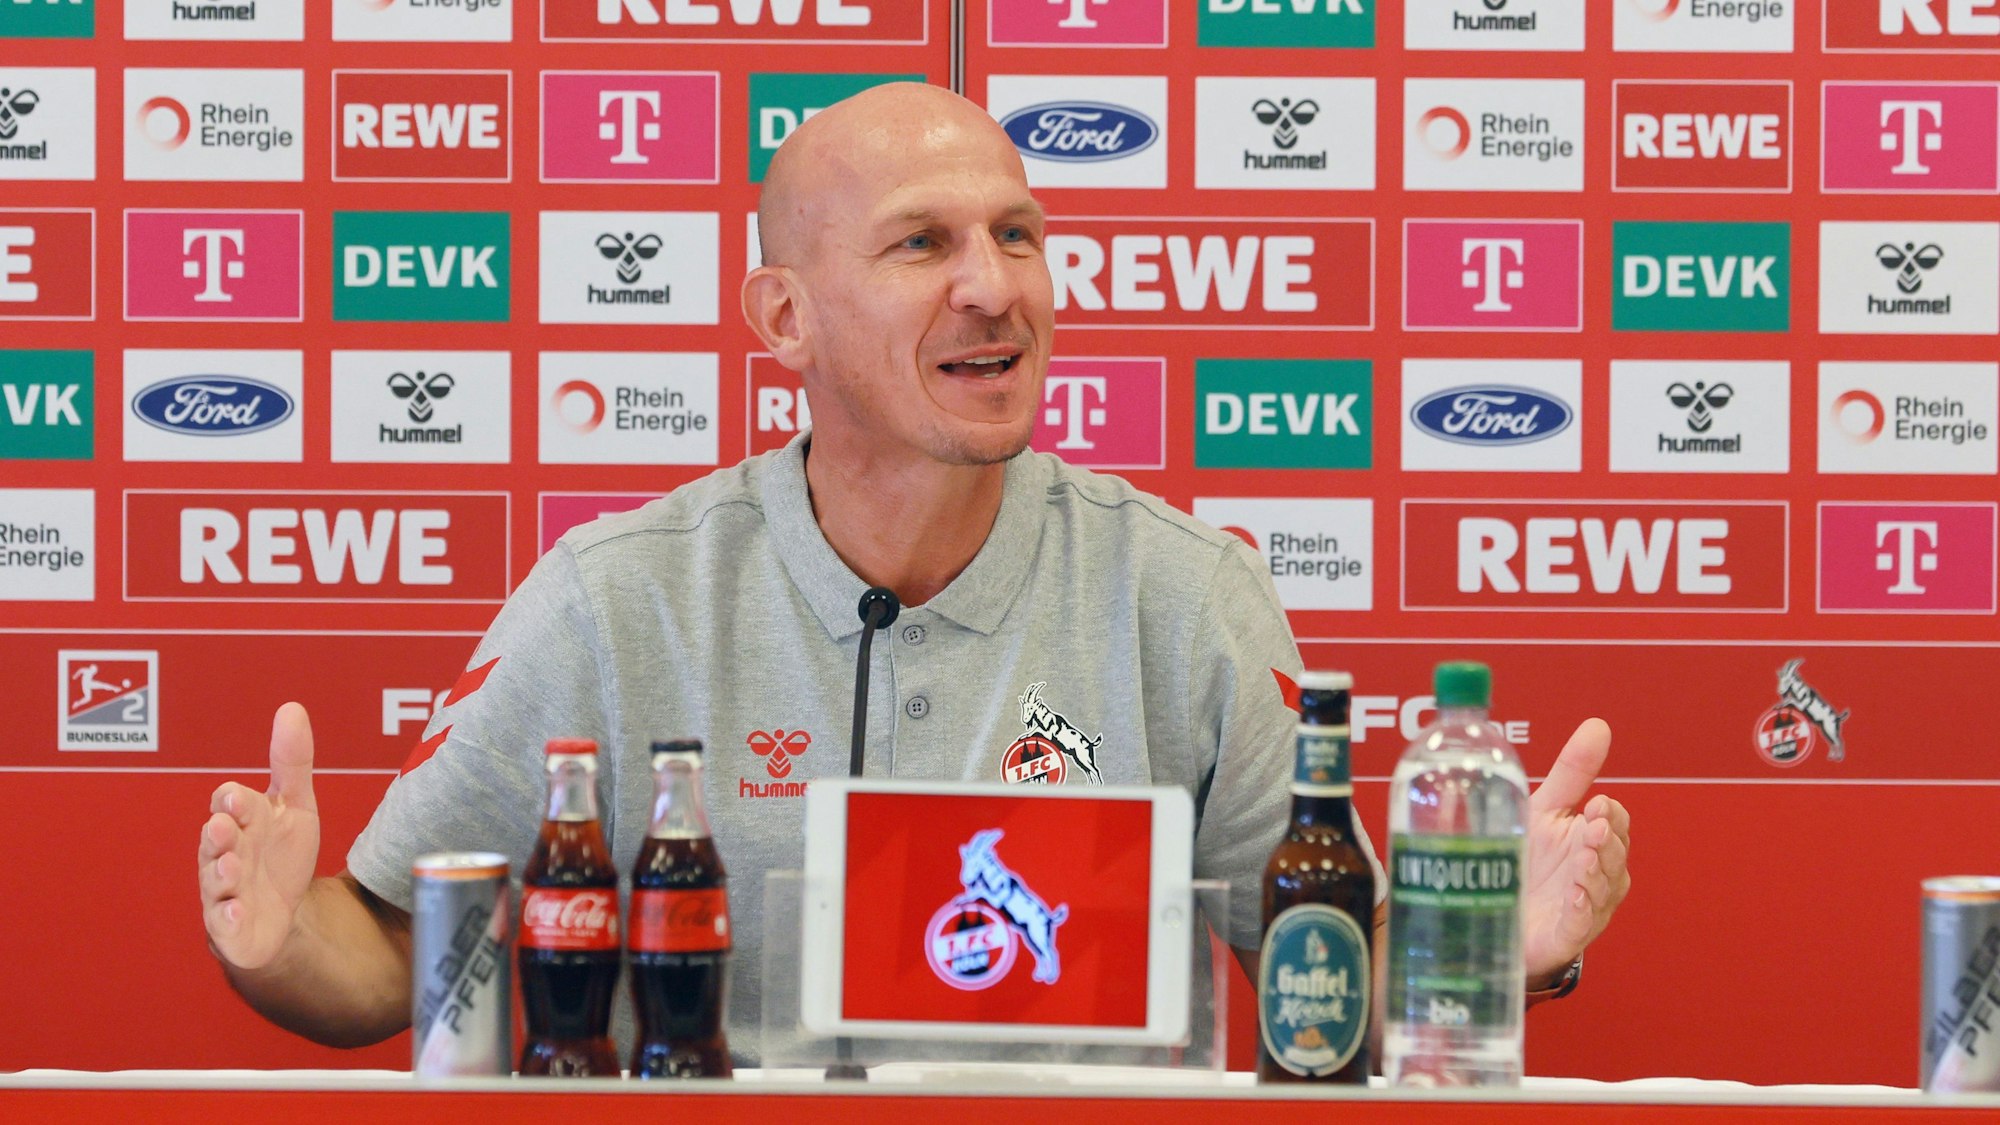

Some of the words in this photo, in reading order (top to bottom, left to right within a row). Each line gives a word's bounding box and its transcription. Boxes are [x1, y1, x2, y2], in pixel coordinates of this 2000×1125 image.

[174, 3, 254, 20] hummel
[1454, 12, 1535, 30] hummel
[202, 104, 268, 123] Rhein
[344, 104, 499, 148] REWE
[600, 91, 659, 163] T
[1483, 114, 1548, 133] Rhein
[202, 127, 292, 150] Energie
[1028, 109, 1126, 151] Ford
[1625, 114, 1780, 158] REWE
[1881, 101, 1941, 173] T
[1245, 150, 1326, 169] hummel
[1482, 137, 1572, 159] Energie
[184, 229, 243, 301] T
[345, 247, 496, 286] DEVK
[1045, 236, 1316, 311] REWE
[1463, 239, 1523, 311] T
[1625, 257, 1776, 296] DEVK
[589, 284, 669, 303] hummel
[1868, 294, 1950, 313] hummel
[163, 384, 260, 427] Ford
[617, 388, 682, 407] Rhein
[1897, 398, 1962, 416] Rhein
[617, 410, 706, 434] Energie
[1046, 377, 1105, 448] T
[1207, 394, 1358, 434] DEVK
[1441, 394, 1538, 437] Ford
[380, 424, 461, 443] hummel
[1659, 433, 1740, 452] hummel
[1896, 420, 1986, 443] Energie
[181, 509, 452, 584] REWE
[1271, 534, 1336, 552] Rhein
[1459, 519, 1730, 593] REWE
[1271, 556, 1361, 580] Energie
[1877, 522, 1937, 593] T
[122, 692, 144, 722] 2
[66, 731, 149, 743] BUNDESLIGA
[1015, 756, 1051, 781] 1.FC
[1429, 996, 1470, 1025] bio
